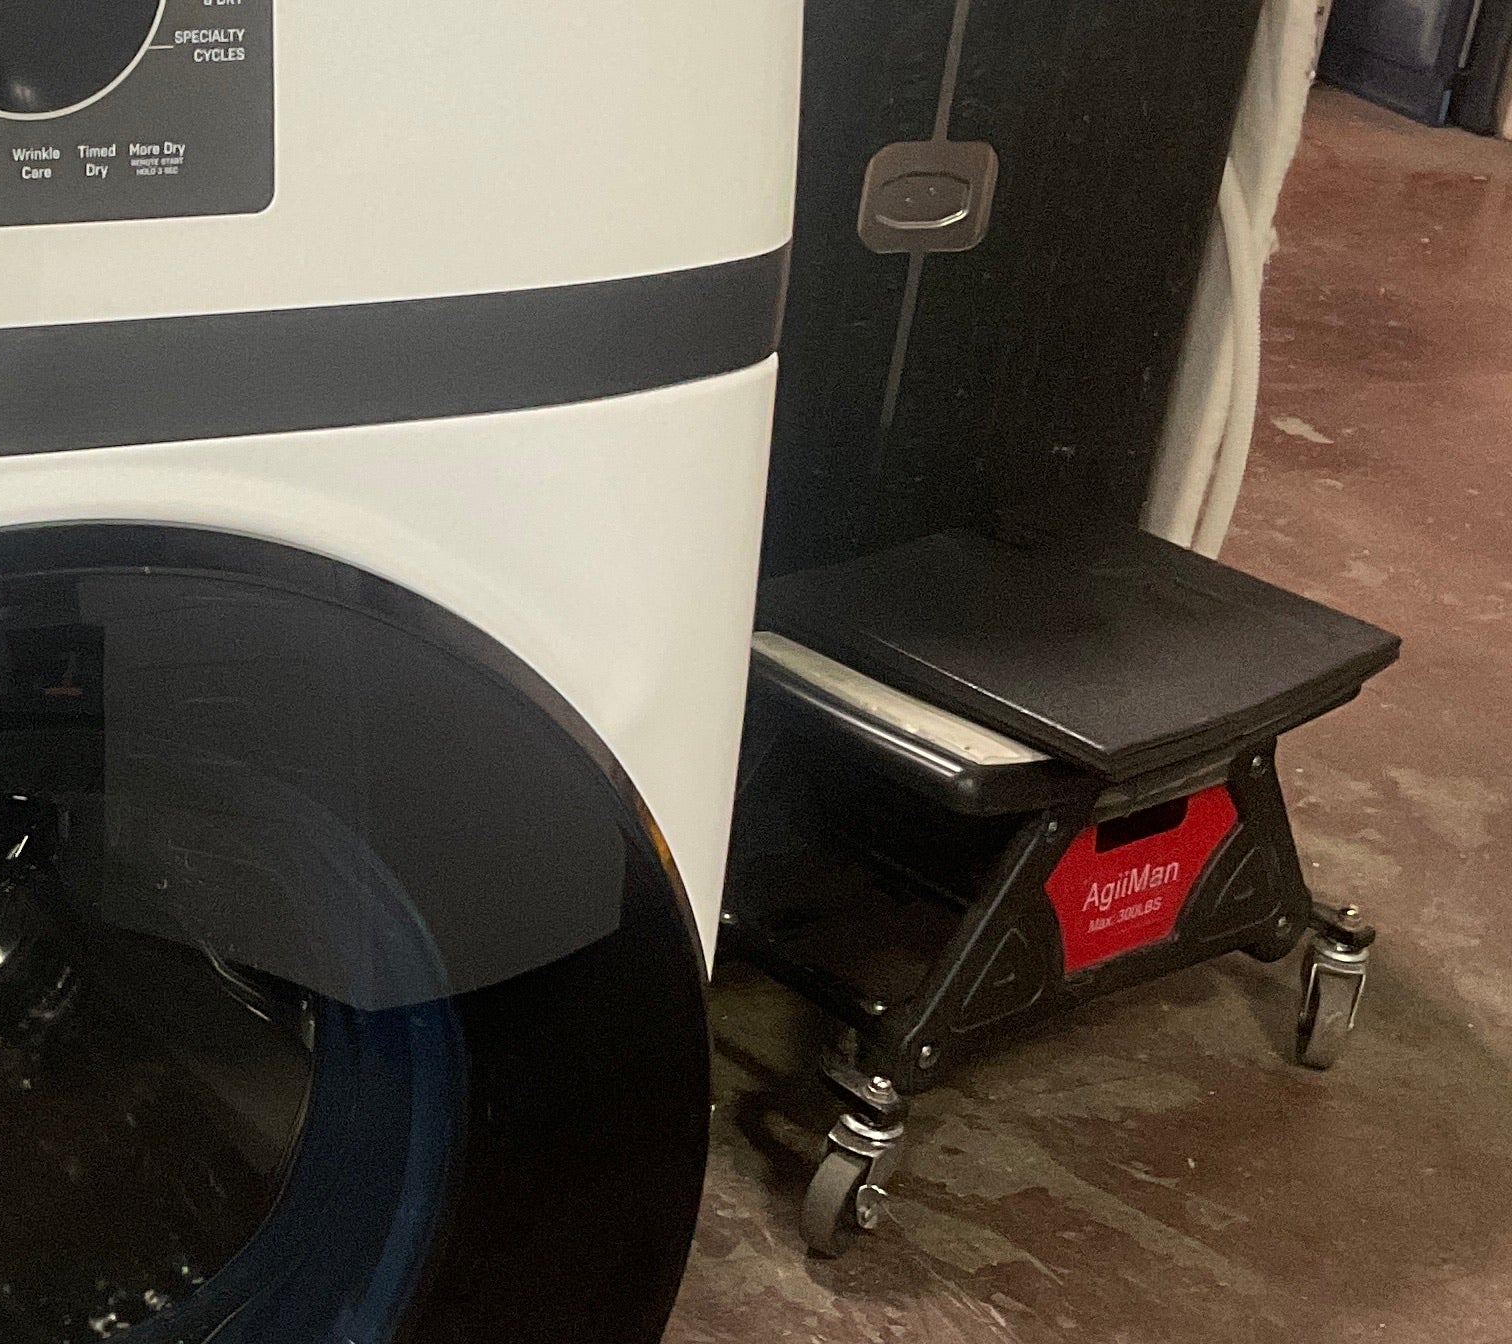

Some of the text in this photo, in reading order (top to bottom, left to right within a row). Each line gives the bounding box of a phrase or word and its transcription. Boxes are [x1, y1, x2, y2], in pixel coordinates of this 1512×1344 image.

[174, 28, 246, 44] SPECIALTY
[193, 47, 246, 63] CYCLES
[12, 147, 61, 162] Wrinkle
[78, 144, 117, 159] Timed
[129, 141, 187, 158] More Dry
[21, 166, 53, 180] Care
[86, 163, 109, 179] Dry
